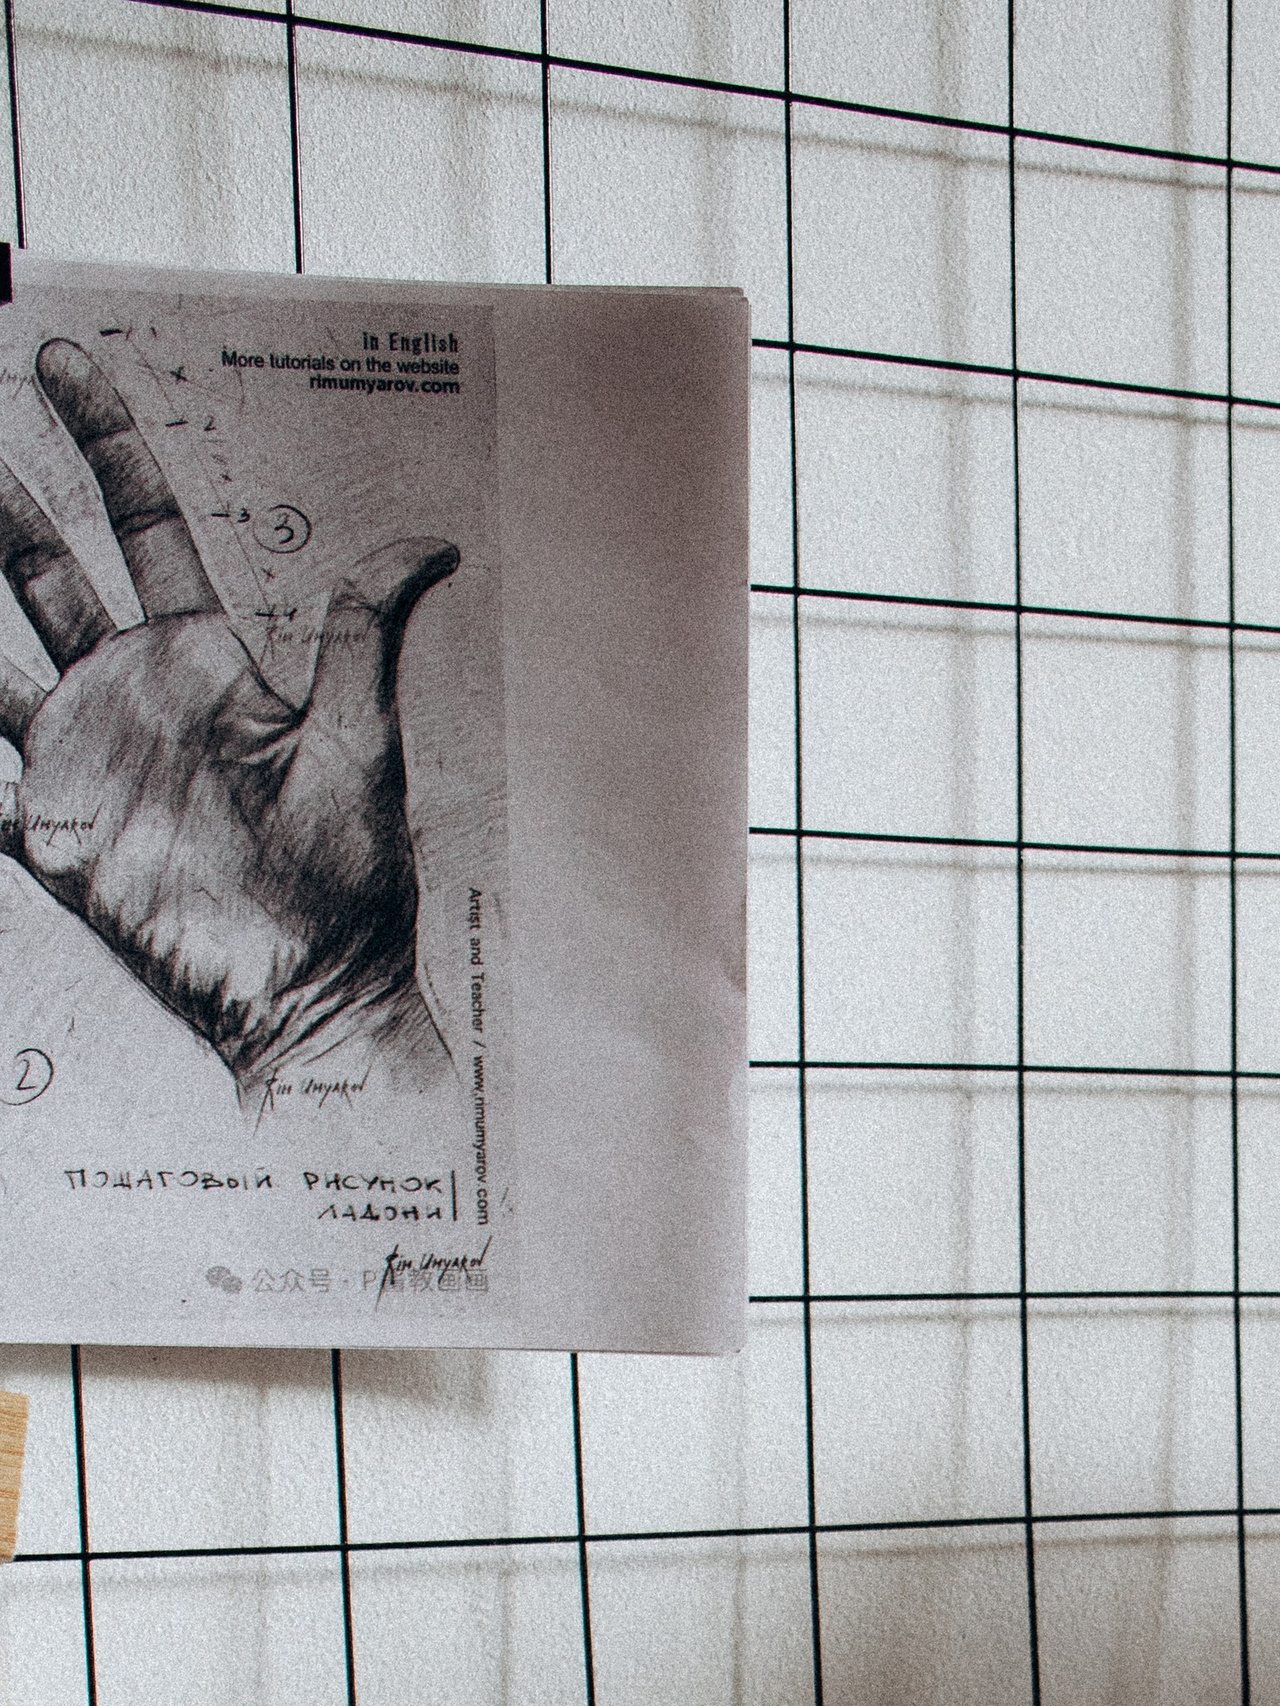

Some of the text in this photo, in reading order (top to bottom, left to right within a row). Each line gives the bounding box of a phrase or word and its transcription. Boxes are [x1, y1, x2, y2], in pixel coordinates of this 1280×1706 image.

[362, 331, 459, 355] in English
[221, 350, 460, 375] More tutorials on the website
[309, 374, 461, 395] rimumyarov.com
[467, 886, 484, 930] Artist
[470, 937, 485, 966] and
[471, 972, 488, 1033] Teacher
[472, 1055, 491, 1226] www.rimumyarov.com
[64, 1166, 442, 1194] ПОШАГОВЫЙ РИСУНОК
[317, 1203, 442, 1222] ЛАДОНИ
[252, 1267, 332, 1293] 公众号
